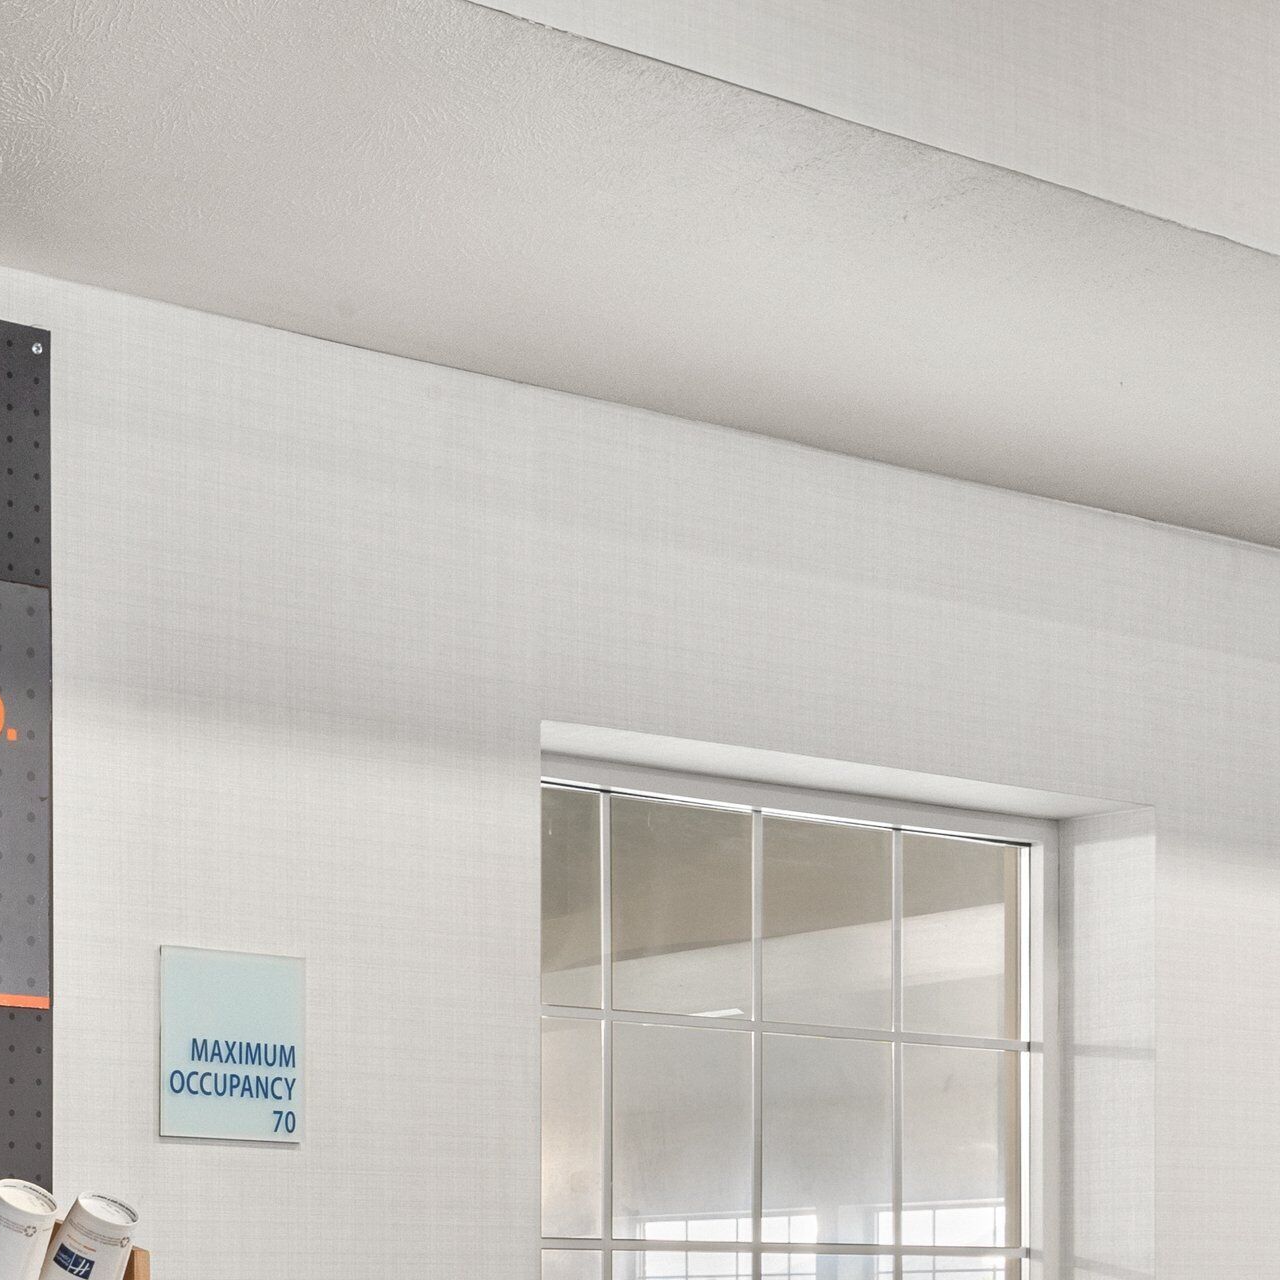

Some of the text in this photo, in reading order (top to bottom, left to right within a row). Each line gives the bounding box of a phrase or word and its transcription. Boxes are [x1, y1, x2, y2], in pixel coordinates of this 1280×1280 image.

[191, 1038, 296, 1068] MAXIMUM
[170, 1069, 296, 1101] OCCUPANCY
[272, 1110, 296, 1134] 70
